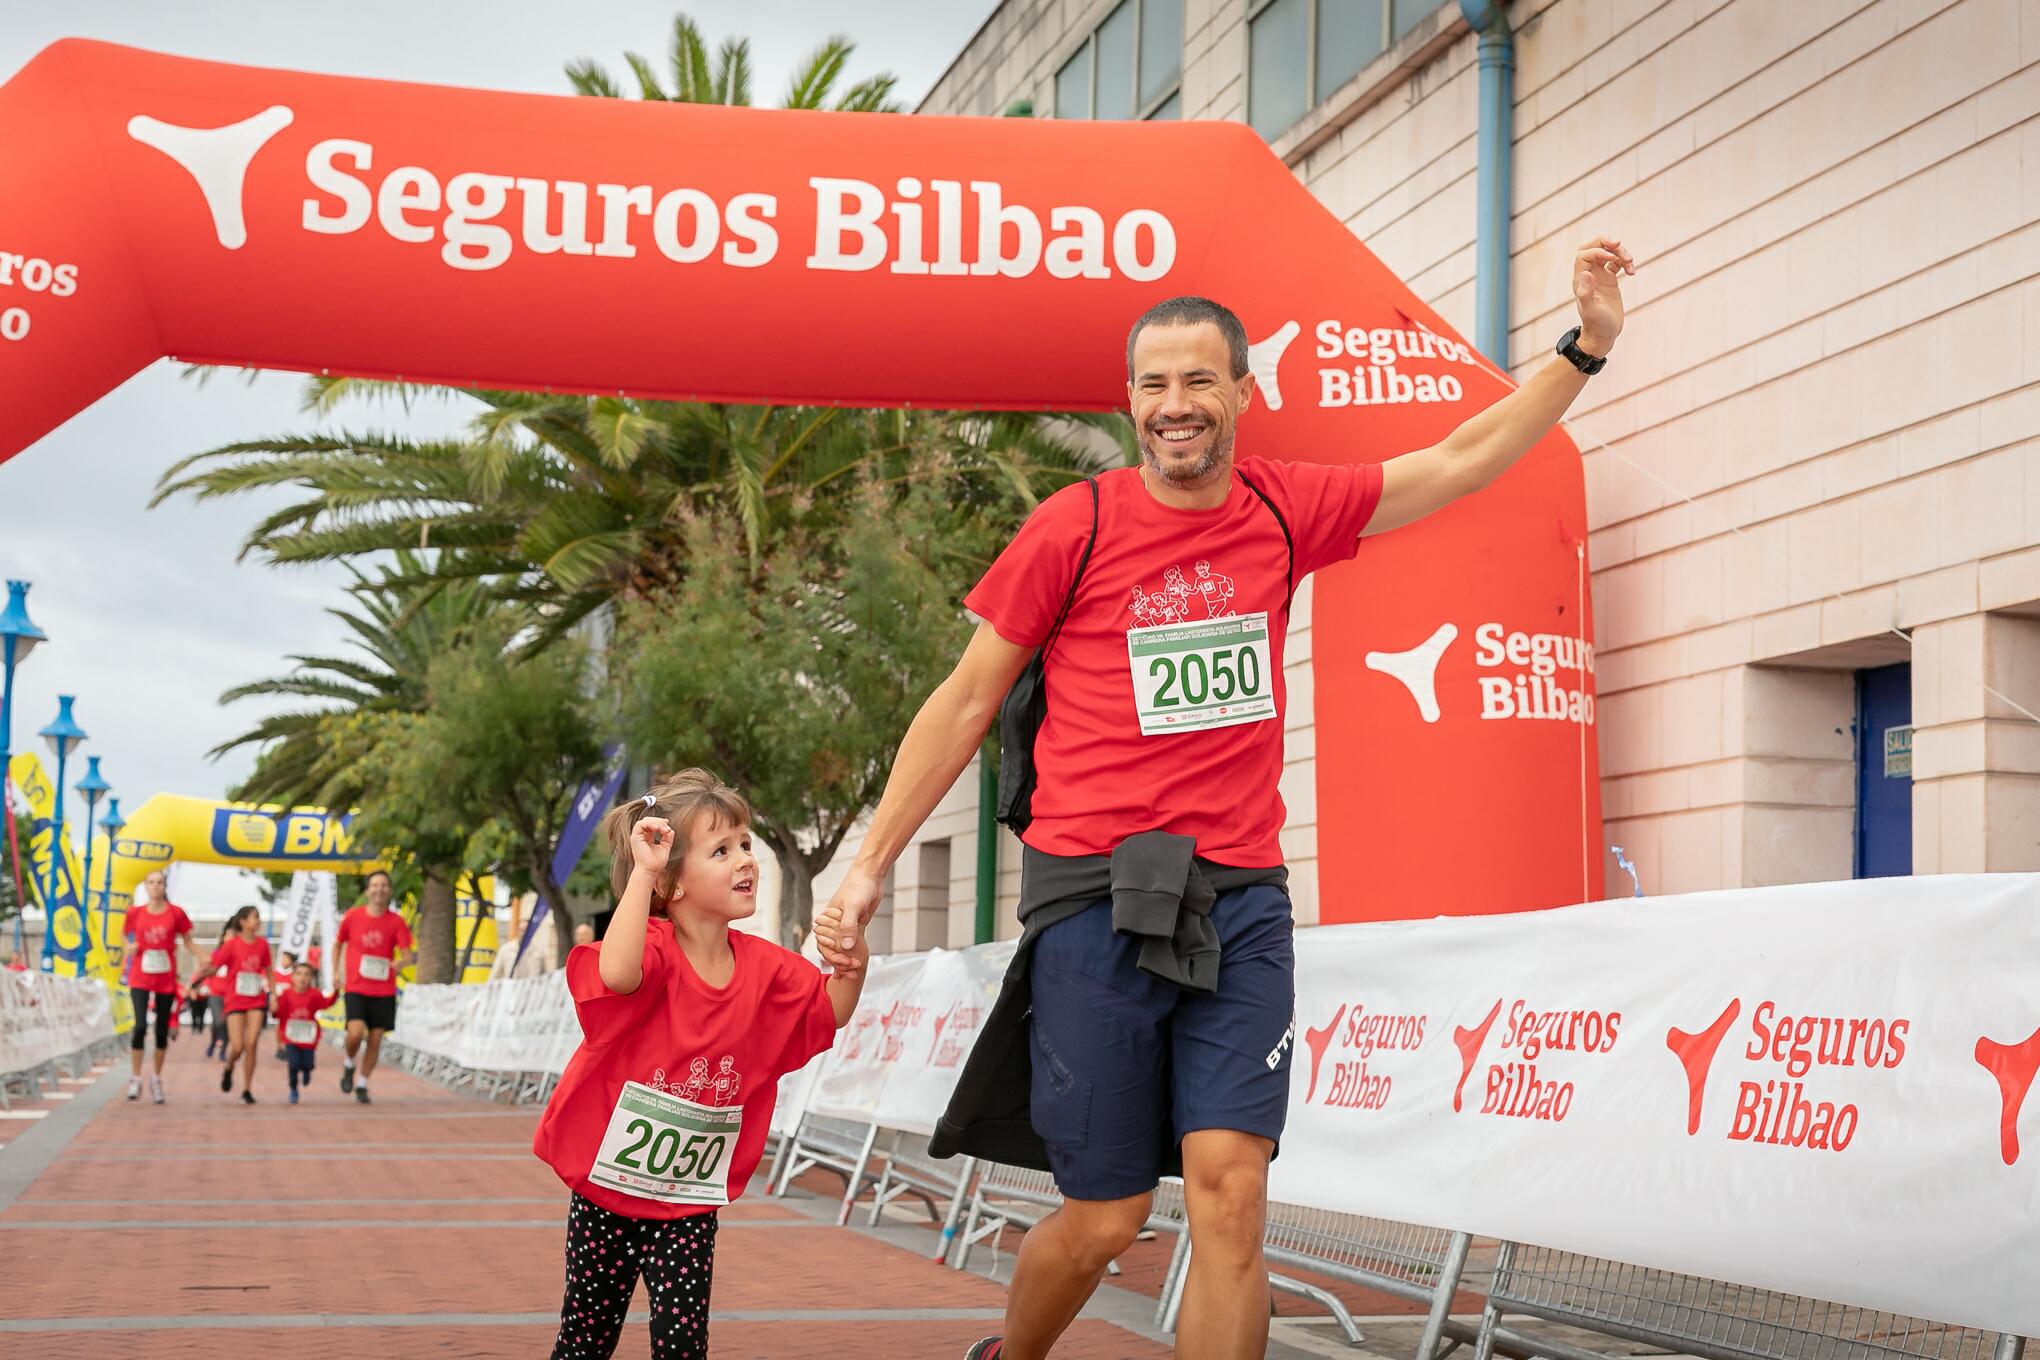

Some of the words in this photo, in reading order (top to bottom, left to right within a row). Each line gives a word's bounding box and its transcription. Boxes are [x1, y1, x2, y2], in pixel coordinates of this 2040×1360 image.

[302, 138, 779, 271] Seguros
[806, 177, 1176, 282] Bilbao
[1315, 319, 1475, 366] Seguros
[1318, 367, 1463, 408] Bilbao
[1150, 646, 1260, 708] 2050
[1475, 622, 1594, 676] Seguro
[1478, 674, 1594, 726] Bilbao
[1342, 1004, 1427, 1053] Seguros
[1501, 999, 1621, 1056] Seguros
[1745, 1000, 1910, 1078] Seguros
[1324, 1062, 1392, 1111] Bilbao
[1480, 1064, 1575, 1122] Bilbao
[1727, 1080, 1859, 1152] Bilbao
[614, 1119, 726, 1180] 2050
